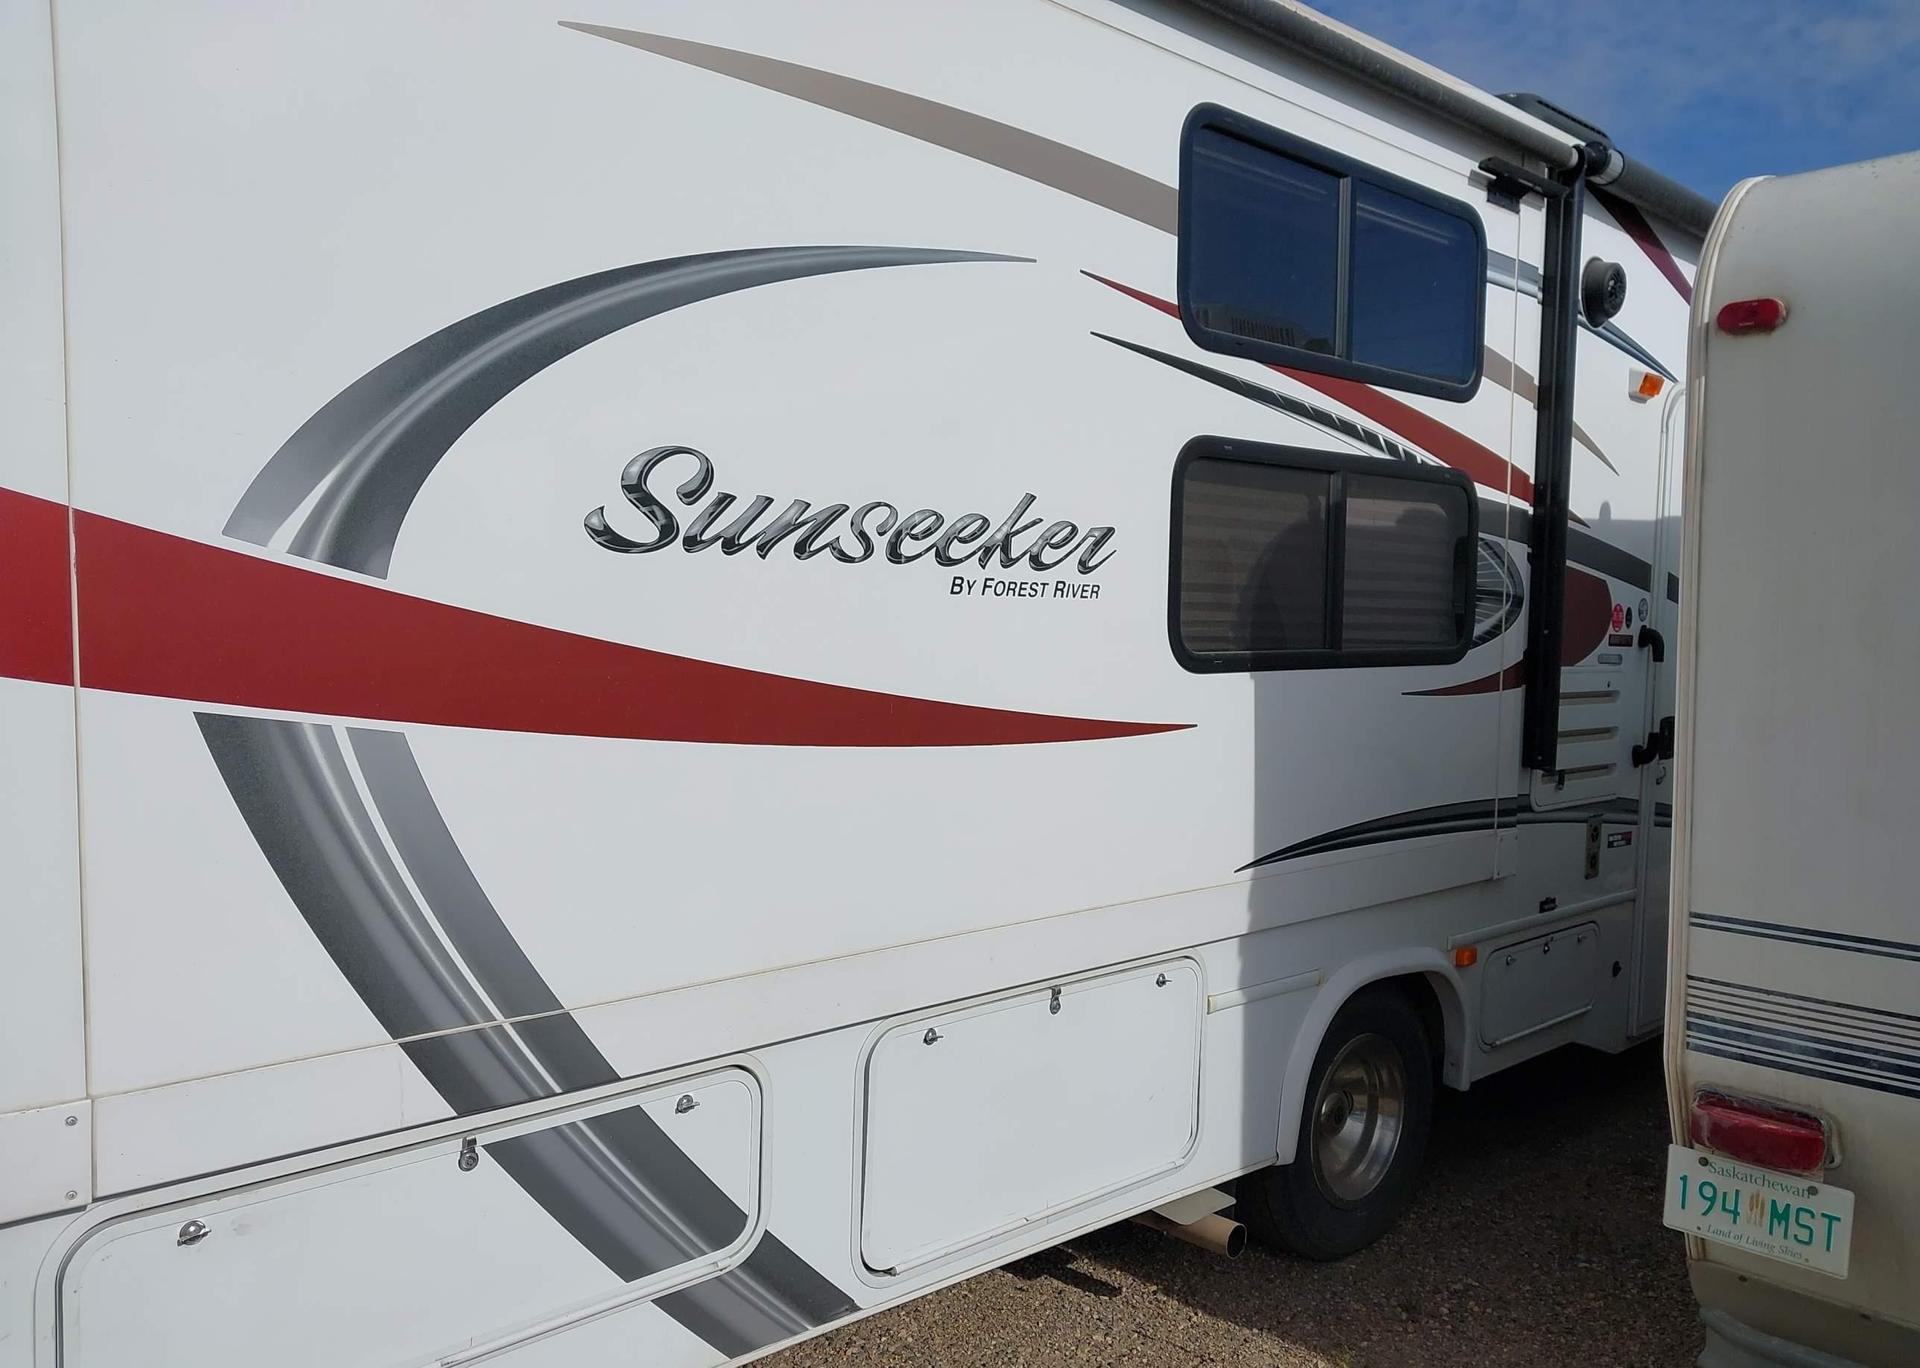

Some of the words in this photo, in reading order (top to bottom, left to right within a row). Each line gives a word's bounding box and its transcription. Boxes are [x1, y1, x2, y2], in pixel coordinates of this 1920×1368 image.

[584, 445, 1117, 575] Sunseeker
[1707, 1161, 1812, 1199] Saskatchewan
[1679, 1174, 1741, 1225] 194
[1768, 1199, 1841, 1252] MST
[1707, 1224, 1731, 1239] Land
[1733, 1233, 1743, 1243] of
[1746, 1236, 1775, 1253] Living
[1778, 1245, 1802, 1259] Skies
